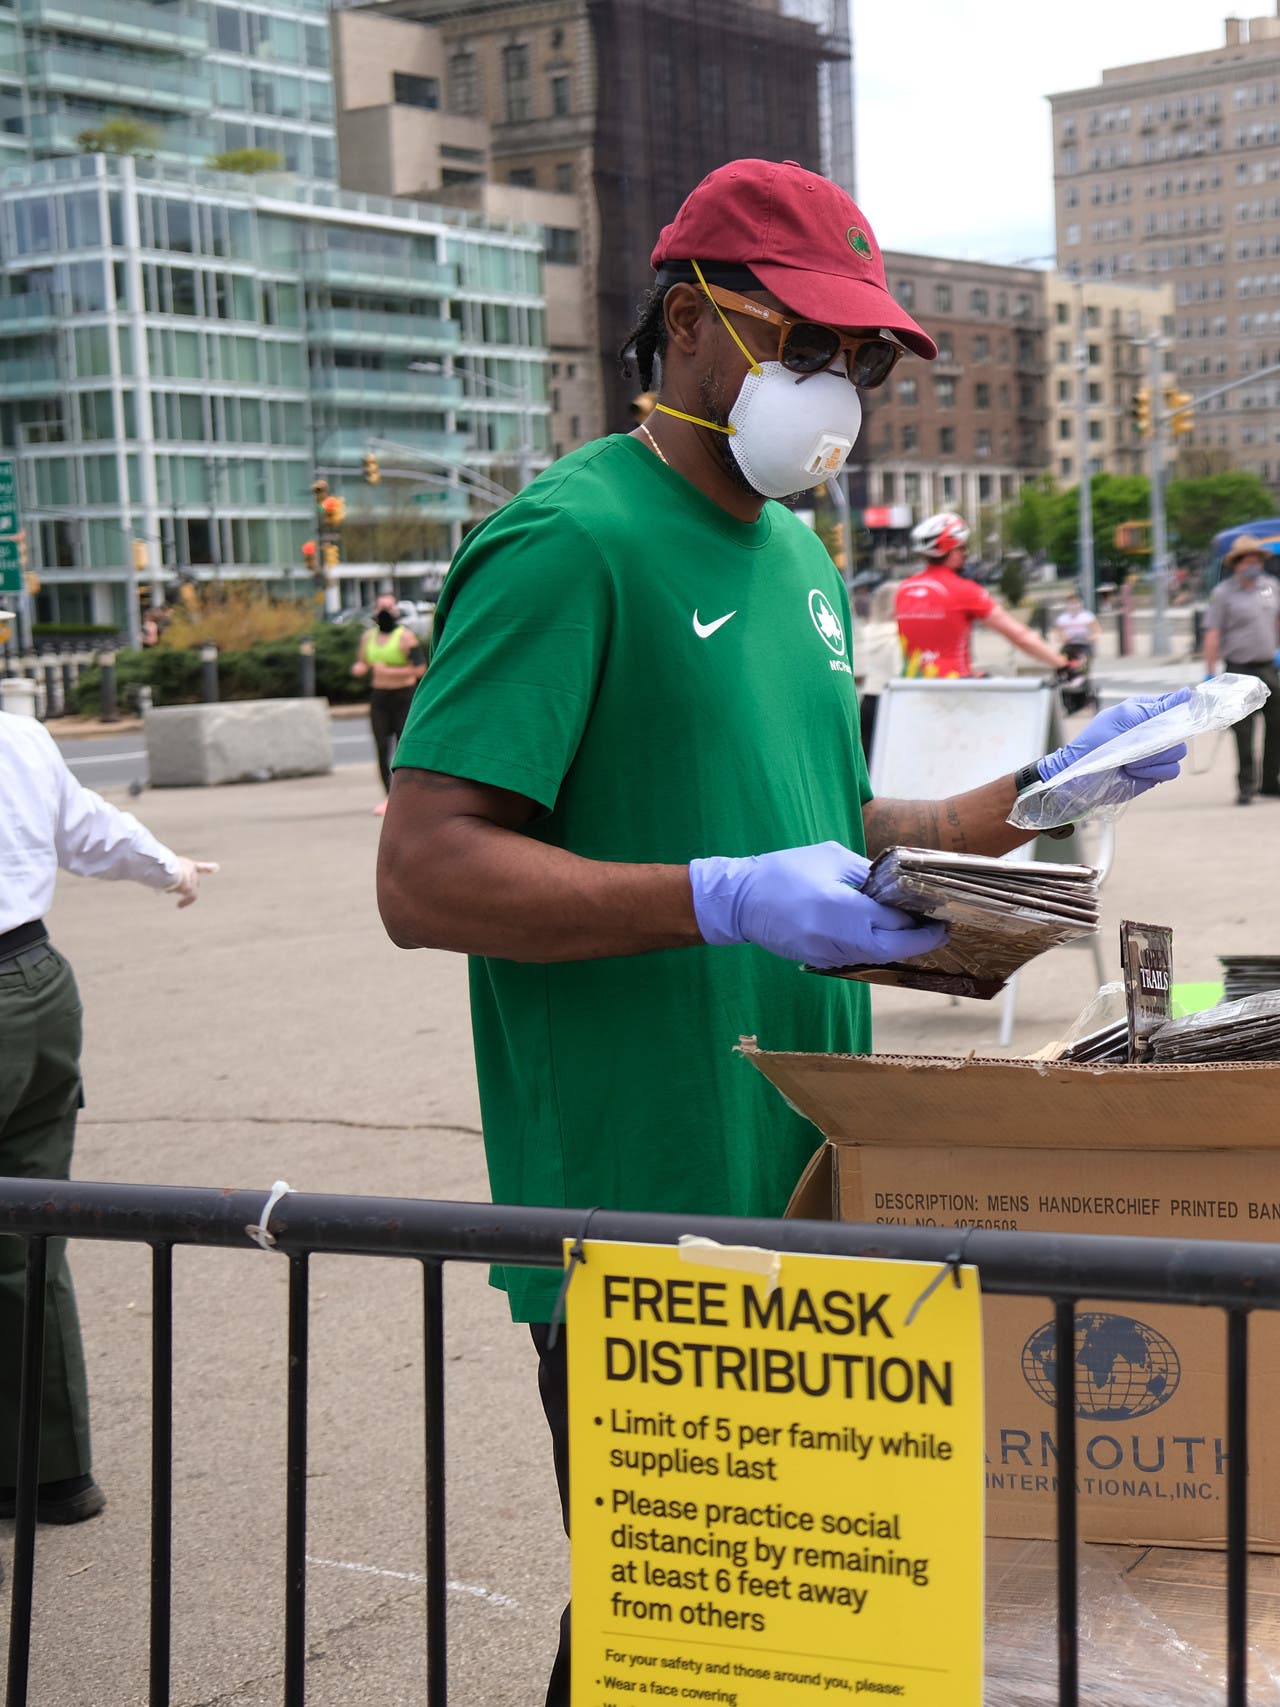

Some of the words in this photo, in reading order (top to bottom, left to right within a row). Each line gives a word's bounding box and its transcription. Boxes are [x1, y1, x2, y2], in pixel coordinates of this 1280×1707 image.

[1140, 968, 1169, 991] TRAILS
[874, 1193, 979, 1211] DESCRIPTION:
[987, 1195, 1030, 1212] MENS
[1039, 1196, 1160, 1215] HANDKERCHIEF
[1171, 1200, 1239, 1218] PRINTED
[602, 1274, 729, 1327] FREE
[742, 1284, 894, 1339] MASK
[605, 1336, 953, 1407] DISTRIBUTION
[611, 1408, 677, 1438] Limit
[682, 1415, 710, 1440] of
[715, 1417, 731, 1442] 5
[738, 1424, 783, 1450] per
[788, 1422, 874, 1461] family
[880, 1431, 953, 1461] while
[610, 1447, 720, 1478] supplies
[727, 1452, 777, 1481] last
[985, 1473, 1220, 1501] INTERTIONAL,INC.
[612, 1489, 698, 1520] Please
[705, 1501, 814, 1532] practice
[821, 1512, 901, 1540] social
[611, 1523, 748, 1568] distancing
[755, 1536, 787, 1570] by
[794, 1547, 929, 1586] remaining
[611, 1560, 637, 1584] at
[644, 1560, 709, 1591] least
[715, 1568, 731, 1593] 6
[737, 1569, 792, 1600] feet
[798, 1582, 868, 1614] away
[610, 1591, 673, 1622] from
[679, 1601, 765, 1632] others
[603, 1675, 637, 1692] Wear
[639, 1683, 647, 1693] a
[649, 1681, 679, 1697] face
[681, 1688, 738, 1707] covering
[605, 1648, 627, 1663] For
[629, 1654, 658, 1668] your
[660, 1656, 703, 1675] safety
[705, 1662, 730, 1675] and
[733, 1664, 771, 1680] those
[773, 1671, 821, 1686] around
[824, 1677, 852, 1692] you,
[855, 1679, 904, 1696] please:
